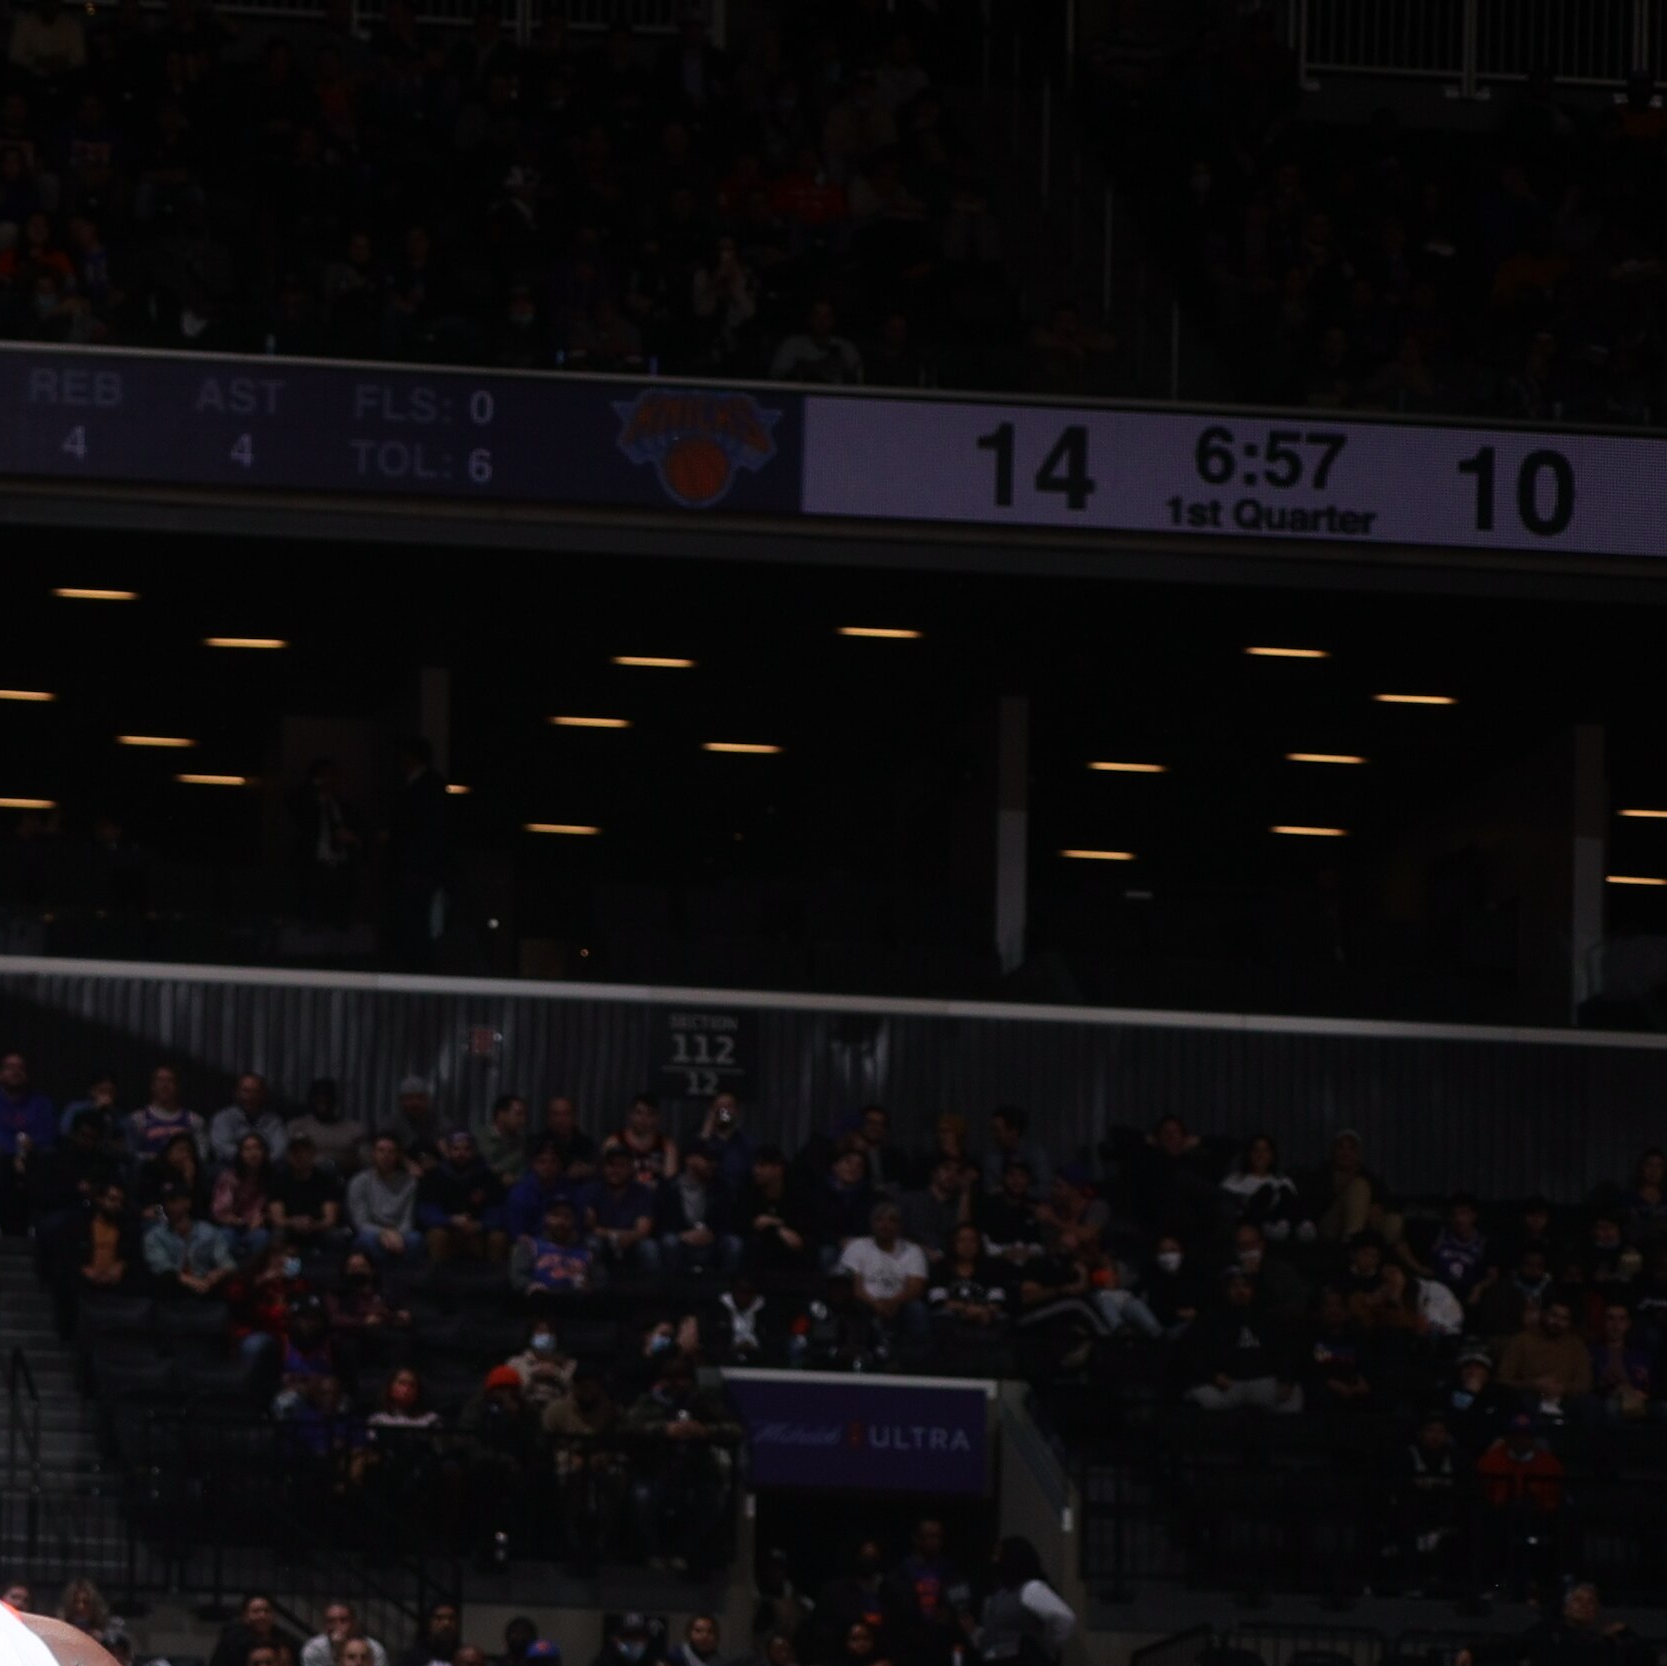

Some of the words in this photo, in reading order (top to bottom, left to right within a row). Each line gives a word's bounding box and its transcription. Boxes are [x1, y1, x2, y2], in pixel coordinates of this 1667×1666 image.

[29, 368, 123, 407] REB
[196, 377, 286, 414] AST
[355, 385, 453, 425] FLS:
[469, 389, 494, 426] 0
[62, 425, 89, 461] 4
[228, 432, 255, 468] 4
[350, 439, 453, 481] TOL:
[467, 447, 494, 482] 6
[1197, 427, 1347, 491] 6:57
[975, 421, 1096, 511] 14
[1457, 446, 1575, 536] 10
[1166, 495, 1226, 531] 1st
[1233, 498, 1377, 537] Quarter
[670, 1032, 736, 1066] 112
[685, 1070, 720, 1096] 12
[866, 1424, 973, 1453] ULTRA
